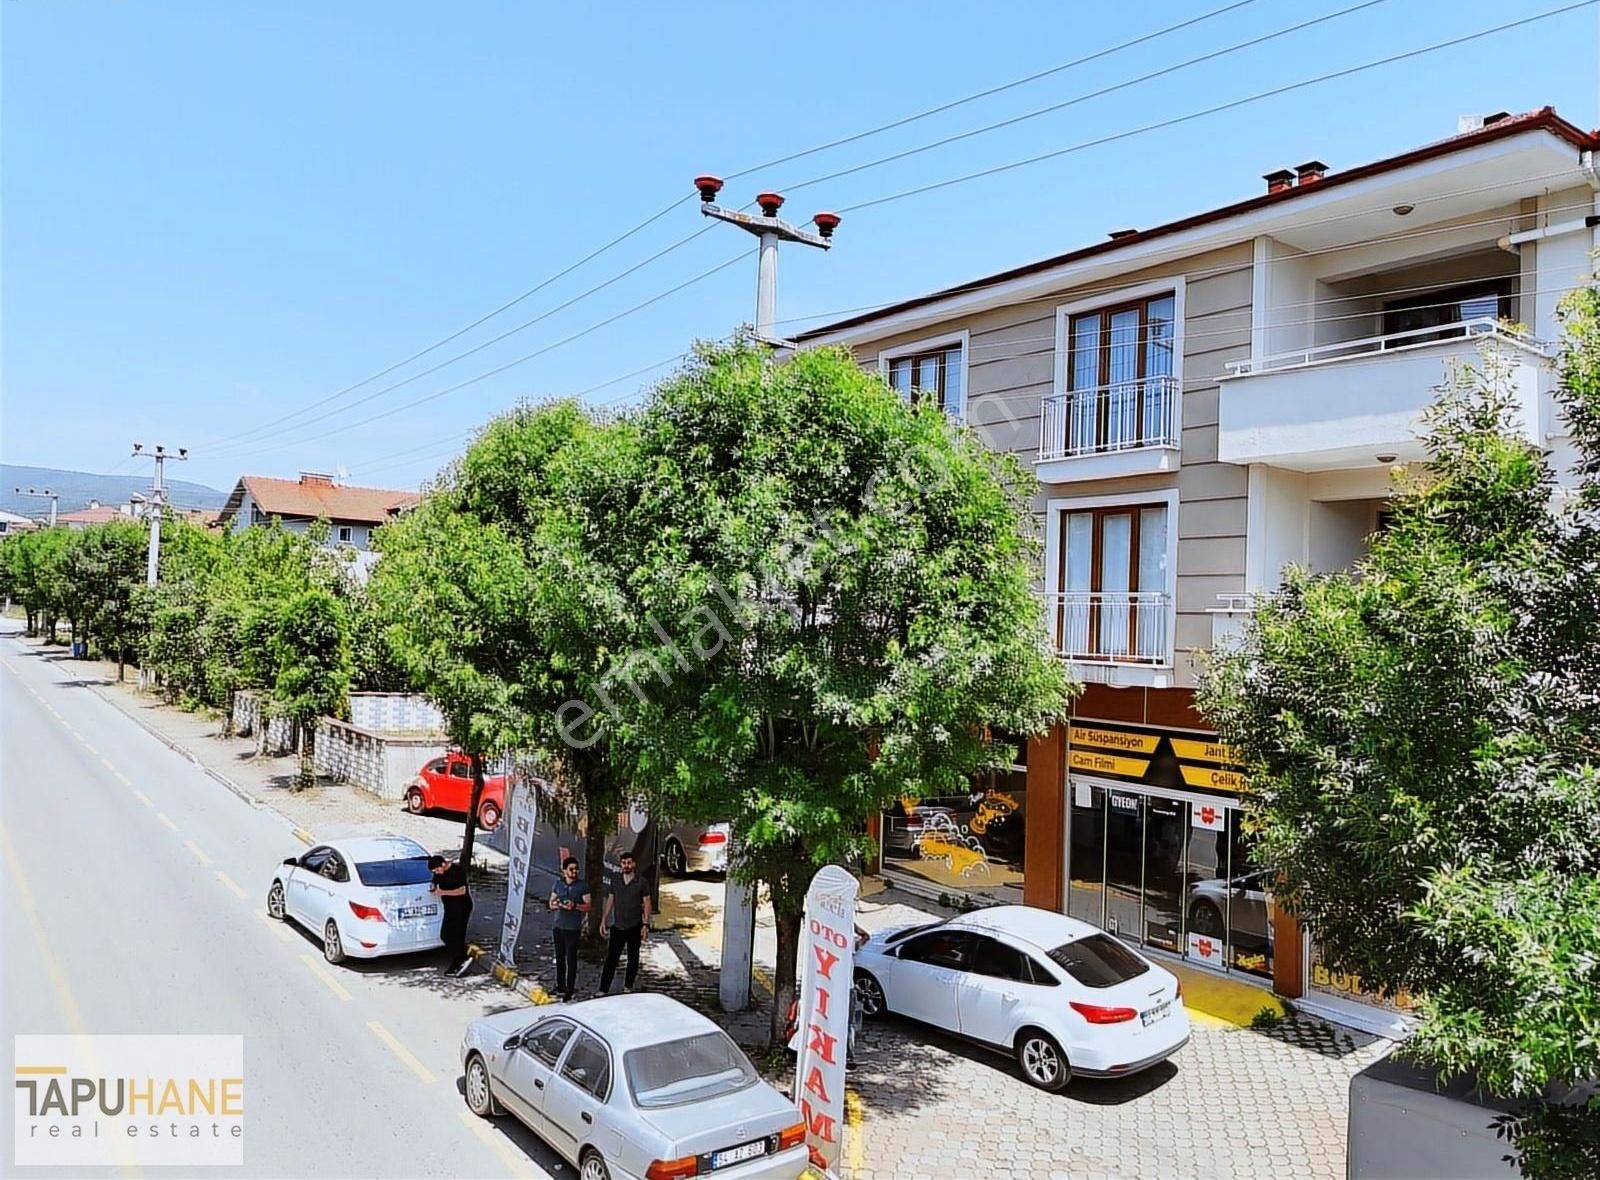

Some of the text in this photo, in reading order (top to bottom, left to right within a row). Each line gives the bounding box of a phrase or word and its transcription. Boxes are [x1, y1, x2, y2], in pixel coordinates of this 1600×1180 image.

[1074, 729, 1086, 740] Air
[1204, 744, 1225, 757] Jant
[1073, 755, 1116, 769] Cam Filmi
[1211, 772, 1237, 786] Çelik
